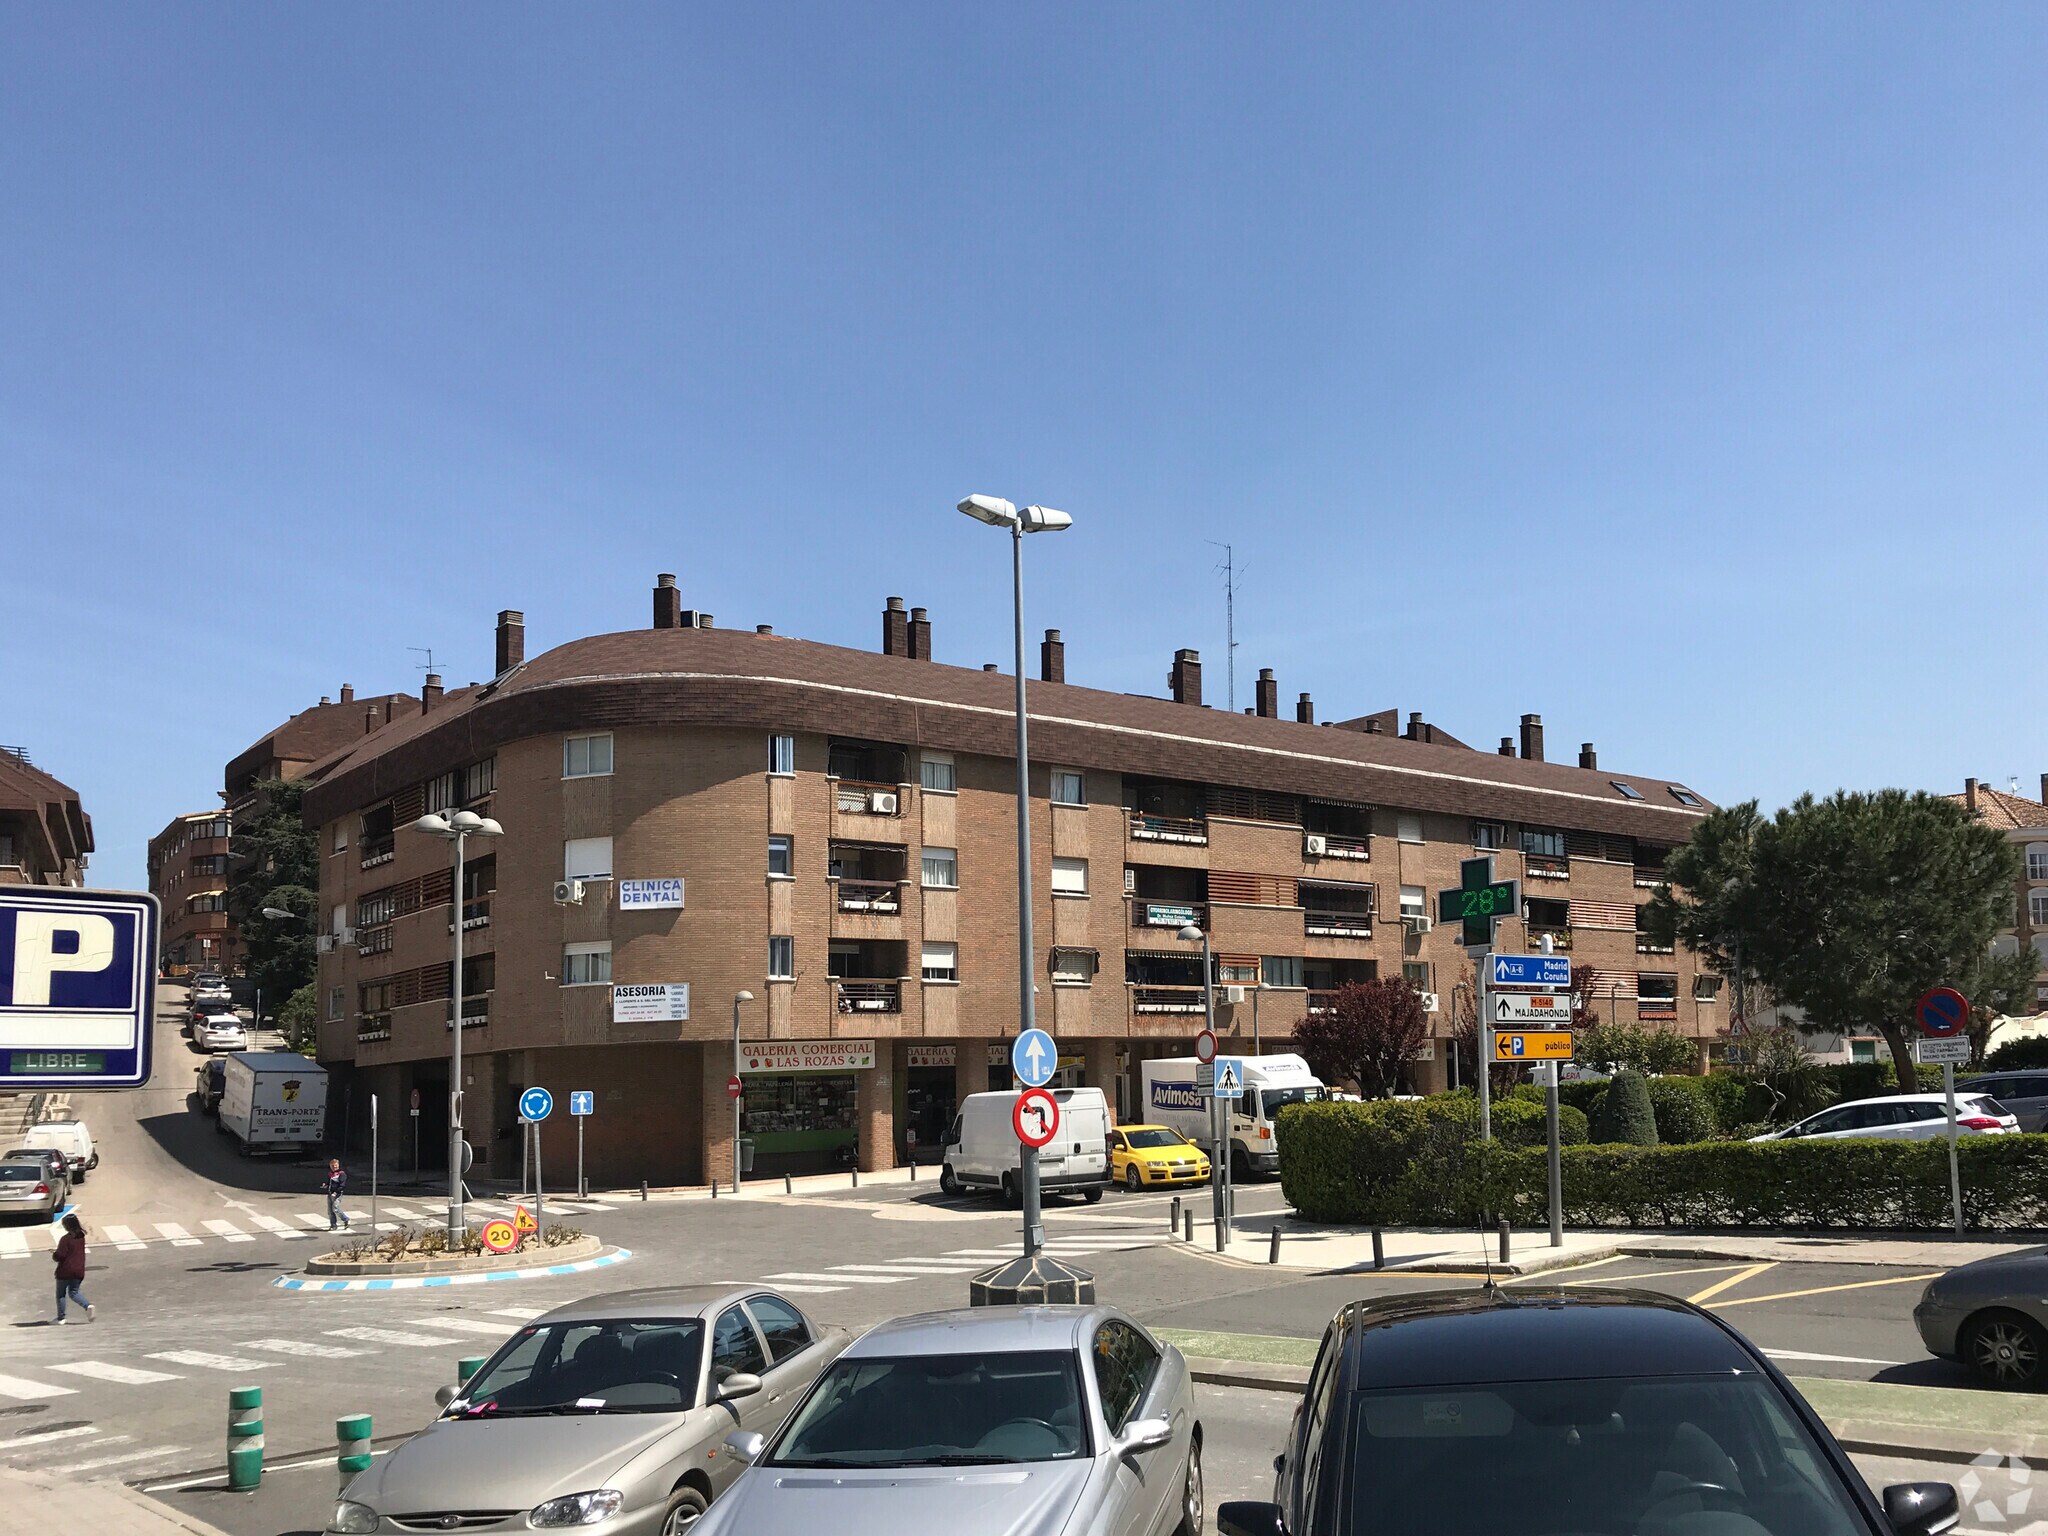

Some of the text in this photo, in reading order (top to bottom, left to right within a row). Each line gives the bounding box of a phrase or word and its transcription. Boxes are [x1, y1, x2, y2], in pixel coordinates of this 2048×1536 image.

[622, 880, 681, 891] CLINICA
[623, 892, 679, 903] DENTAL
[12, 911, 114, 1005] P
[1544, 961, 1567, 970] Madrid
[1536, 972, 1541, 980] A
[615, 986, 666, 997] ASESORIA
[1515, 1009, 1569, 1018] MAJADAHONDA
[743, 1044, 872, 1056] GALERIA COMERCIAL
[1514, 1038, 1570, 1054] P público
[26, 1054, 87, 1067] LIBRE
[777, 1056, 844, 1067] LAS ROZAS
[933, 1057, 950, 1065] LAS
[1153, 1086, 1202, 1106] Avimosa
[491, 1230, 511, 1241] 20
